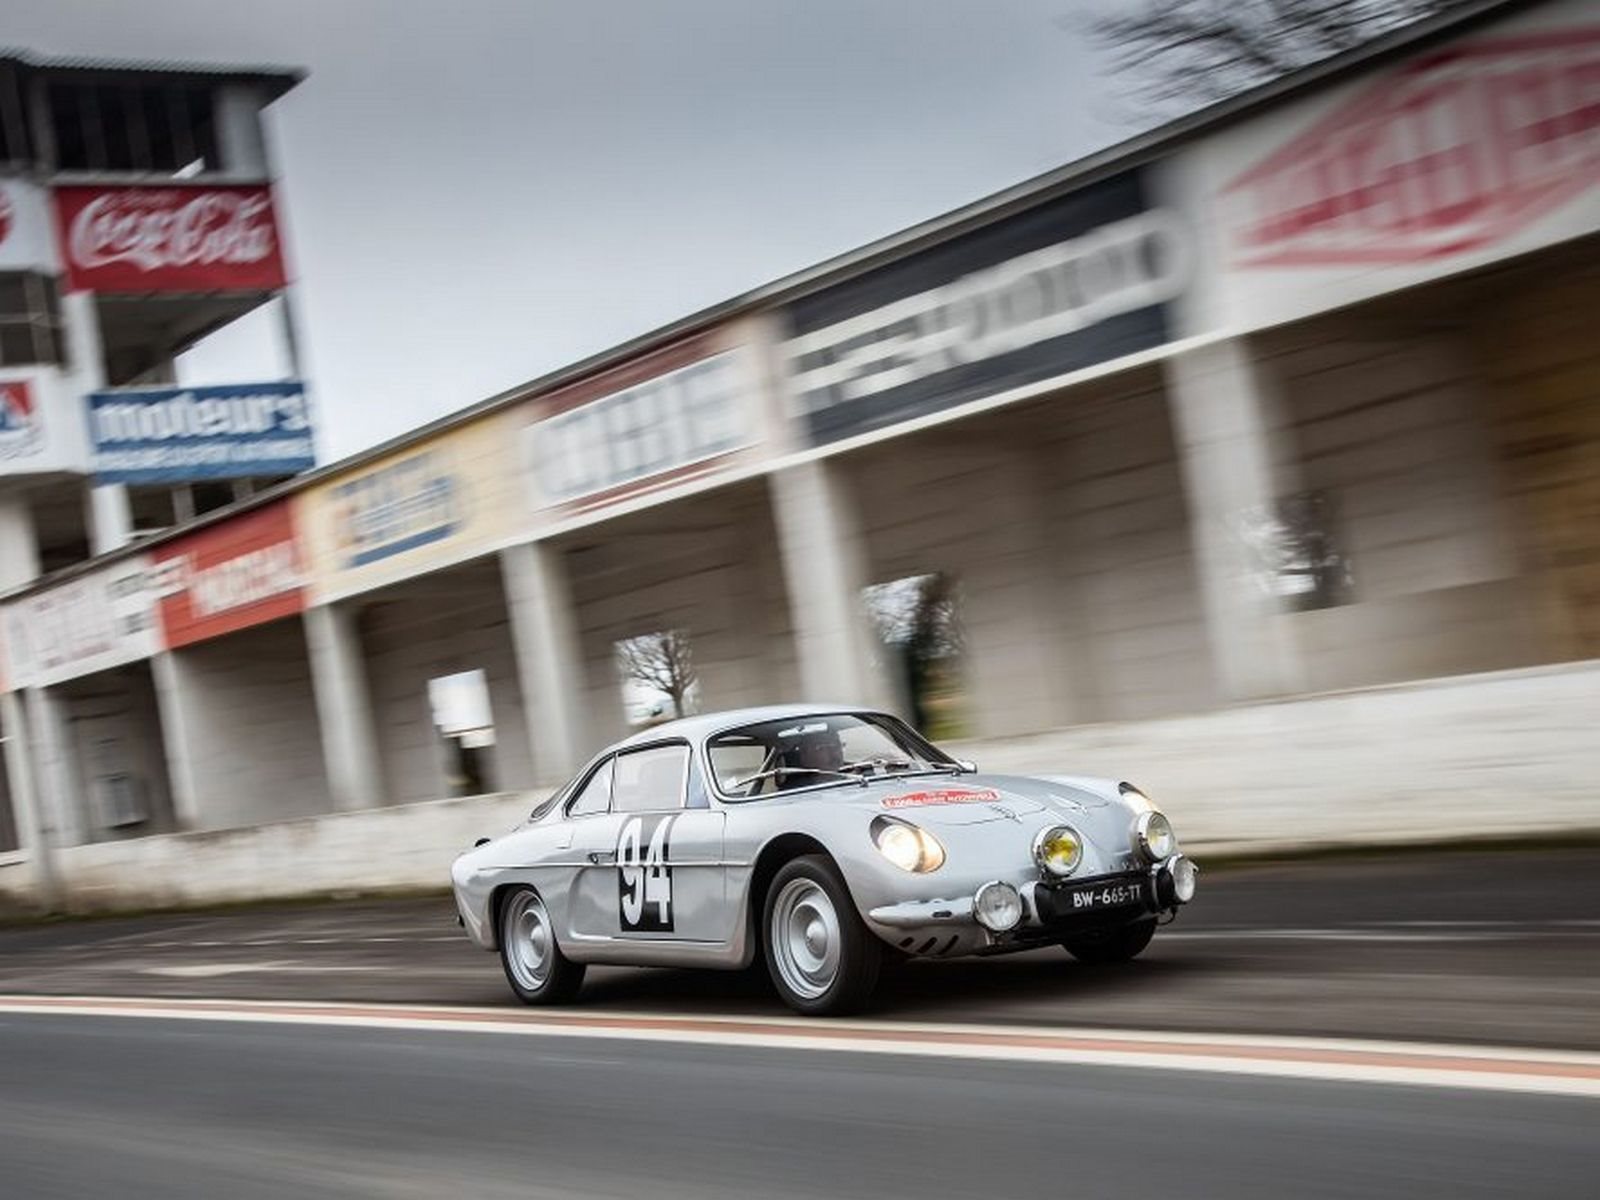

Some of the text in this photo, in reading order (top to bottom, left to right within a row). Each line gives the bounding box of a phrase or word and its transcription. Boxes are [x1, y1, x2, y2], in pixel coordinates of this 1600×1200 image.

[93, 392, 311, 442] moteurs
[616, 815, 671, 925] 94
[1072, 884, 1141, 908] BW-665-TT
